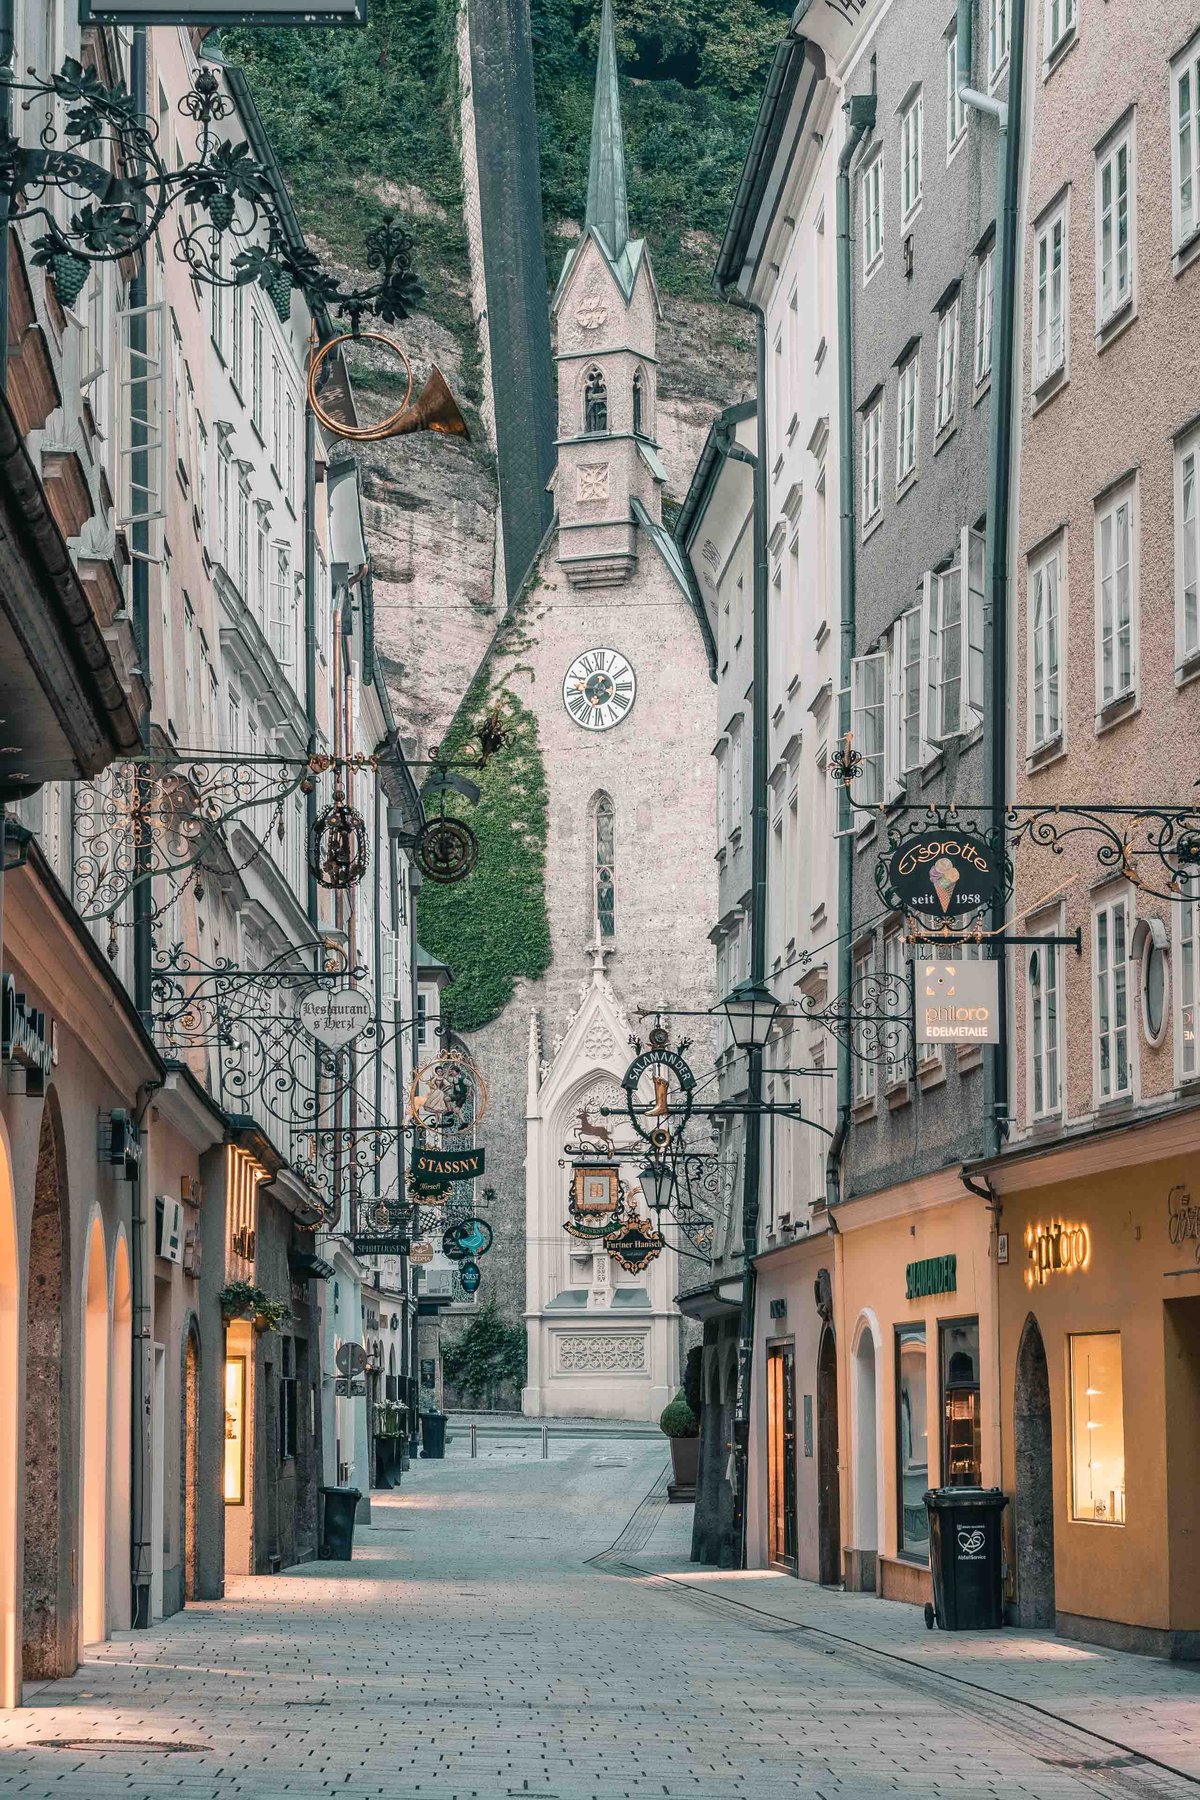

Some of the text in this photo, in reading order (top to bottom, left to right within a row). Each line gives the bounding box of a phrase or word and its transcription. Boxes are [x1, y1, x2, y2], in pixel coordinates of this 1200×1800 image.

[899, 841, 989, 875] Eisgrotte
[911, 893, 981, 905] seit 1958
[925, 1005, 990, 1026] philoro
[926, 1026, 988, 1037] EDELMETALLE
[629, 1051, 691, 1081] SALAMANDER
[418, 1156, 479, 1174] STASSNY
[906, 1254, 957, 1299] SALAMANDER
